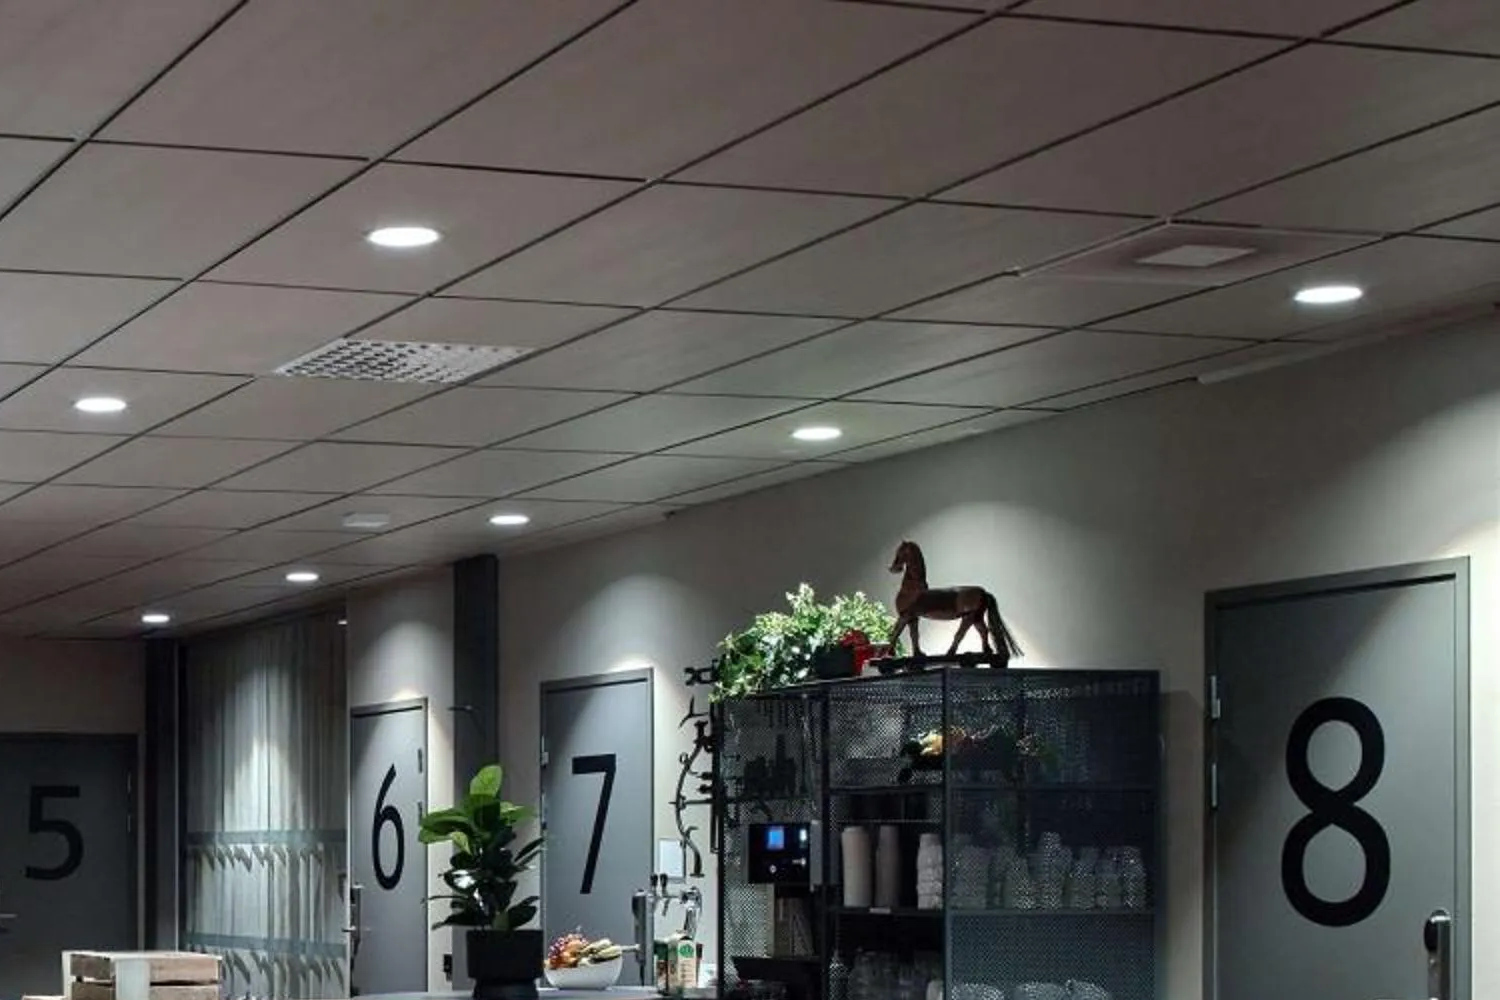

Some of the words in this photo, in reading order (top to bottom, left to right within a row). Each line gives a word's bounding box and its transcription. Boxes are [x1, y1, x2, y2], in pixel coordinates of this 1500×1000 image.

[25, 785, 84, 880] 5
[372, 764, 404, 890] 6
[572, 754, 616, 894] 7
[1281, 697, 1390, 927] 8
